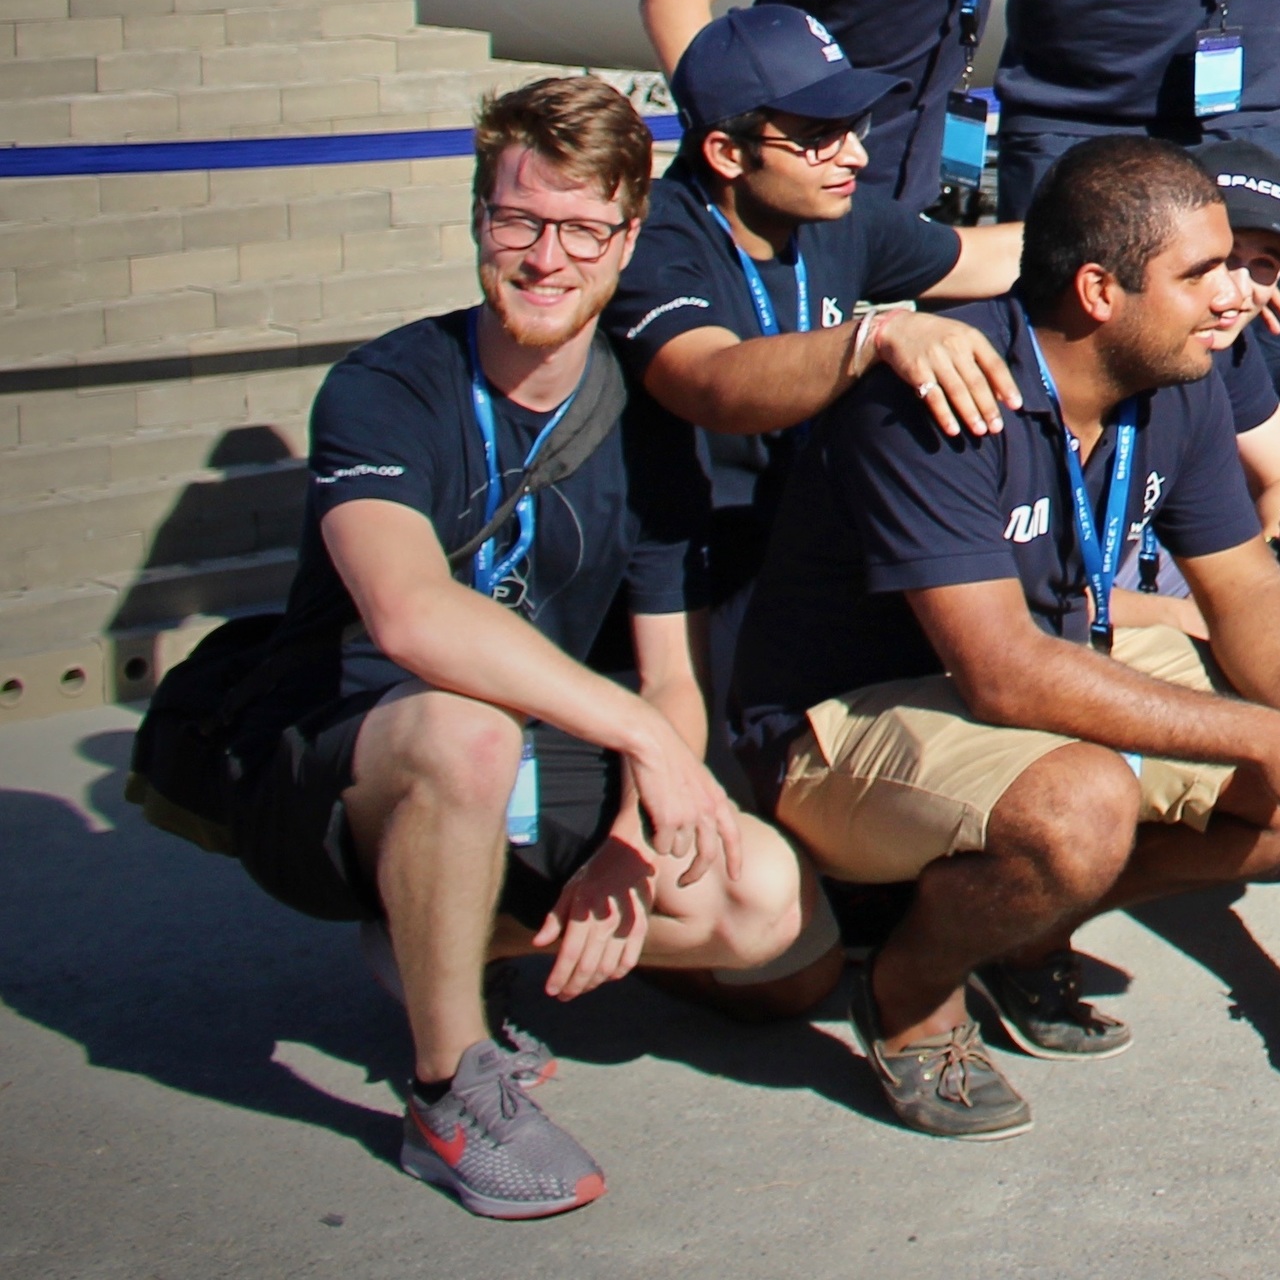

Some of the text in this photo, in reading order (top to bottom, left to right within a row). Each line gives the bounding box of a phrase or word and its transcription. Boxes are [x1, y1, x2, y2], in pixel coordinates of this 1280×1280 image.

[1116, 424, 1131, 480] SPACEX
[1003, 496, 1050, 544] TUM
[1075, 487, 1091, 541] SPACEX
[1103, 516, 1118, 573] SPACEX
